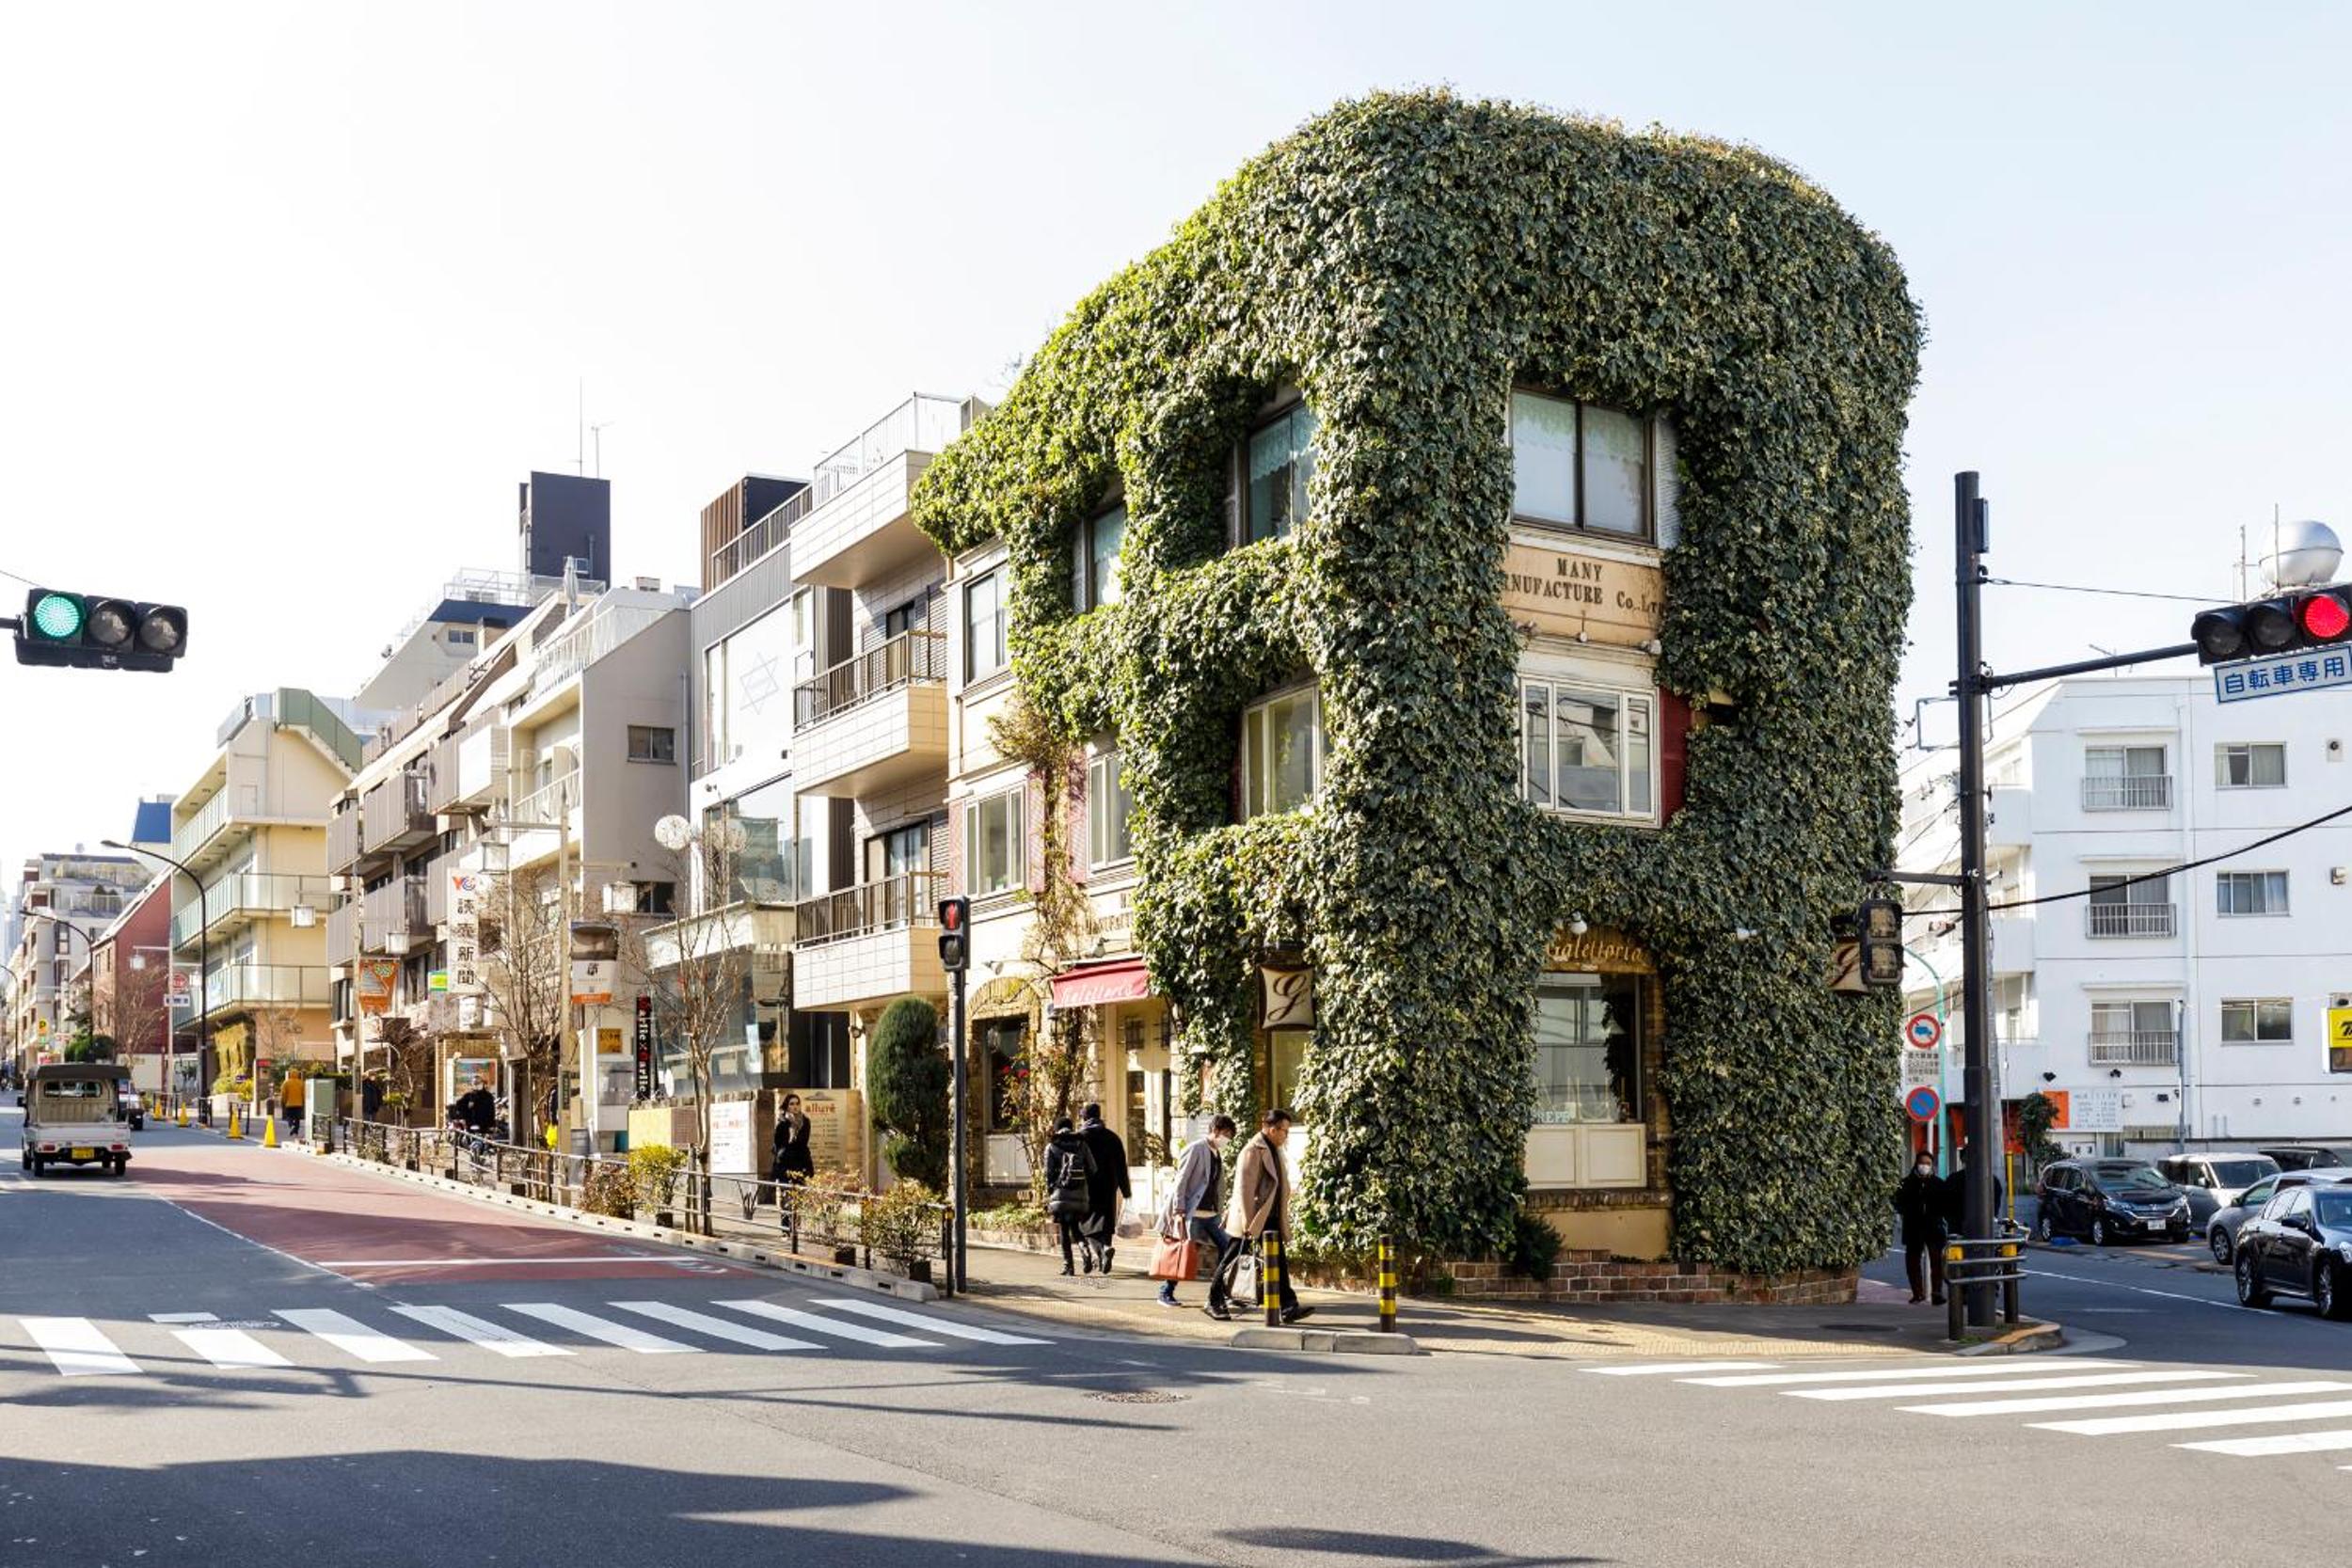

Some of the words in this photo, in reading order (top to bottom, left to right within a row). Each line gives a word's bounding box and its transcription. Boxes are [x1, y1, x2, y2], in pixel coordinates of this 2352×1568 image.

[1557, 558, 1602, 582] MANY
[2225, 657, 2344, 693] 自転車専用
